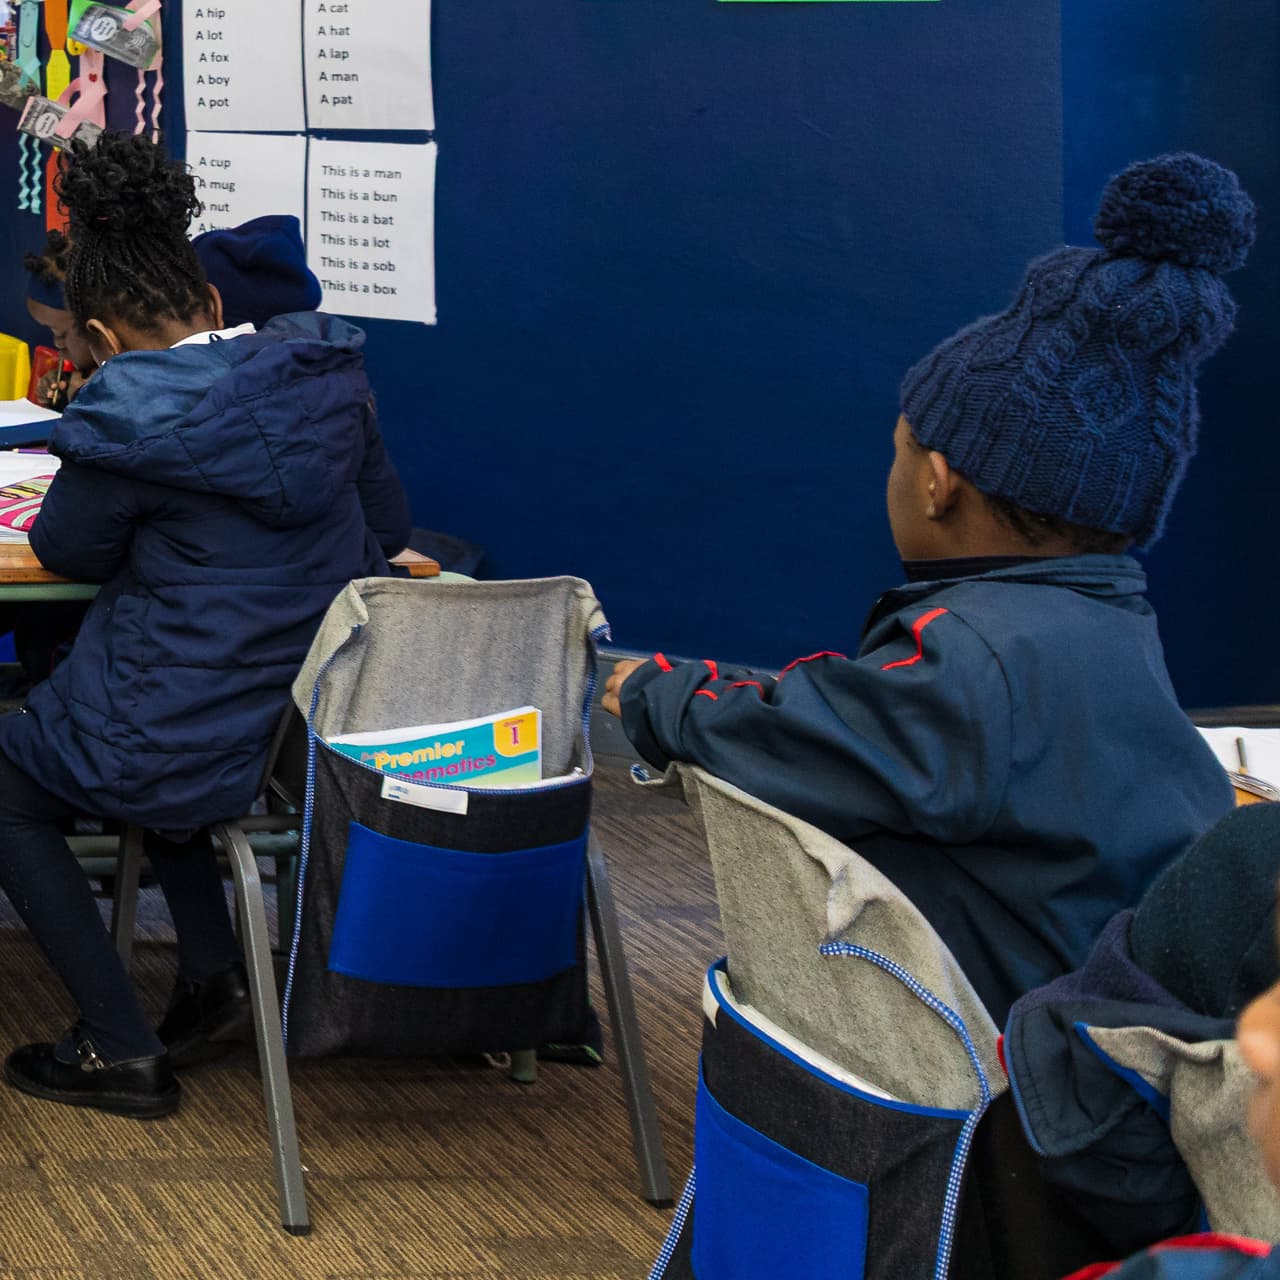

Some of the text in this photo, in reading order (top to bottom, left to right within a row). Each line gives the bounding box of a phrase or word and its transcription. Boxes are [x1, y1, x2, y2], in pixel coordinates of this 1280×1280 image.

[196, 8, 225, 20] A hip
[200, 52, 229, 62] A fox
[318, 48, 349, 60] A lap
[322, 165, 402, 180] This is a man
[321, 188, 397, 202] This is a bun
[375, 740, 464, 769] Premier
